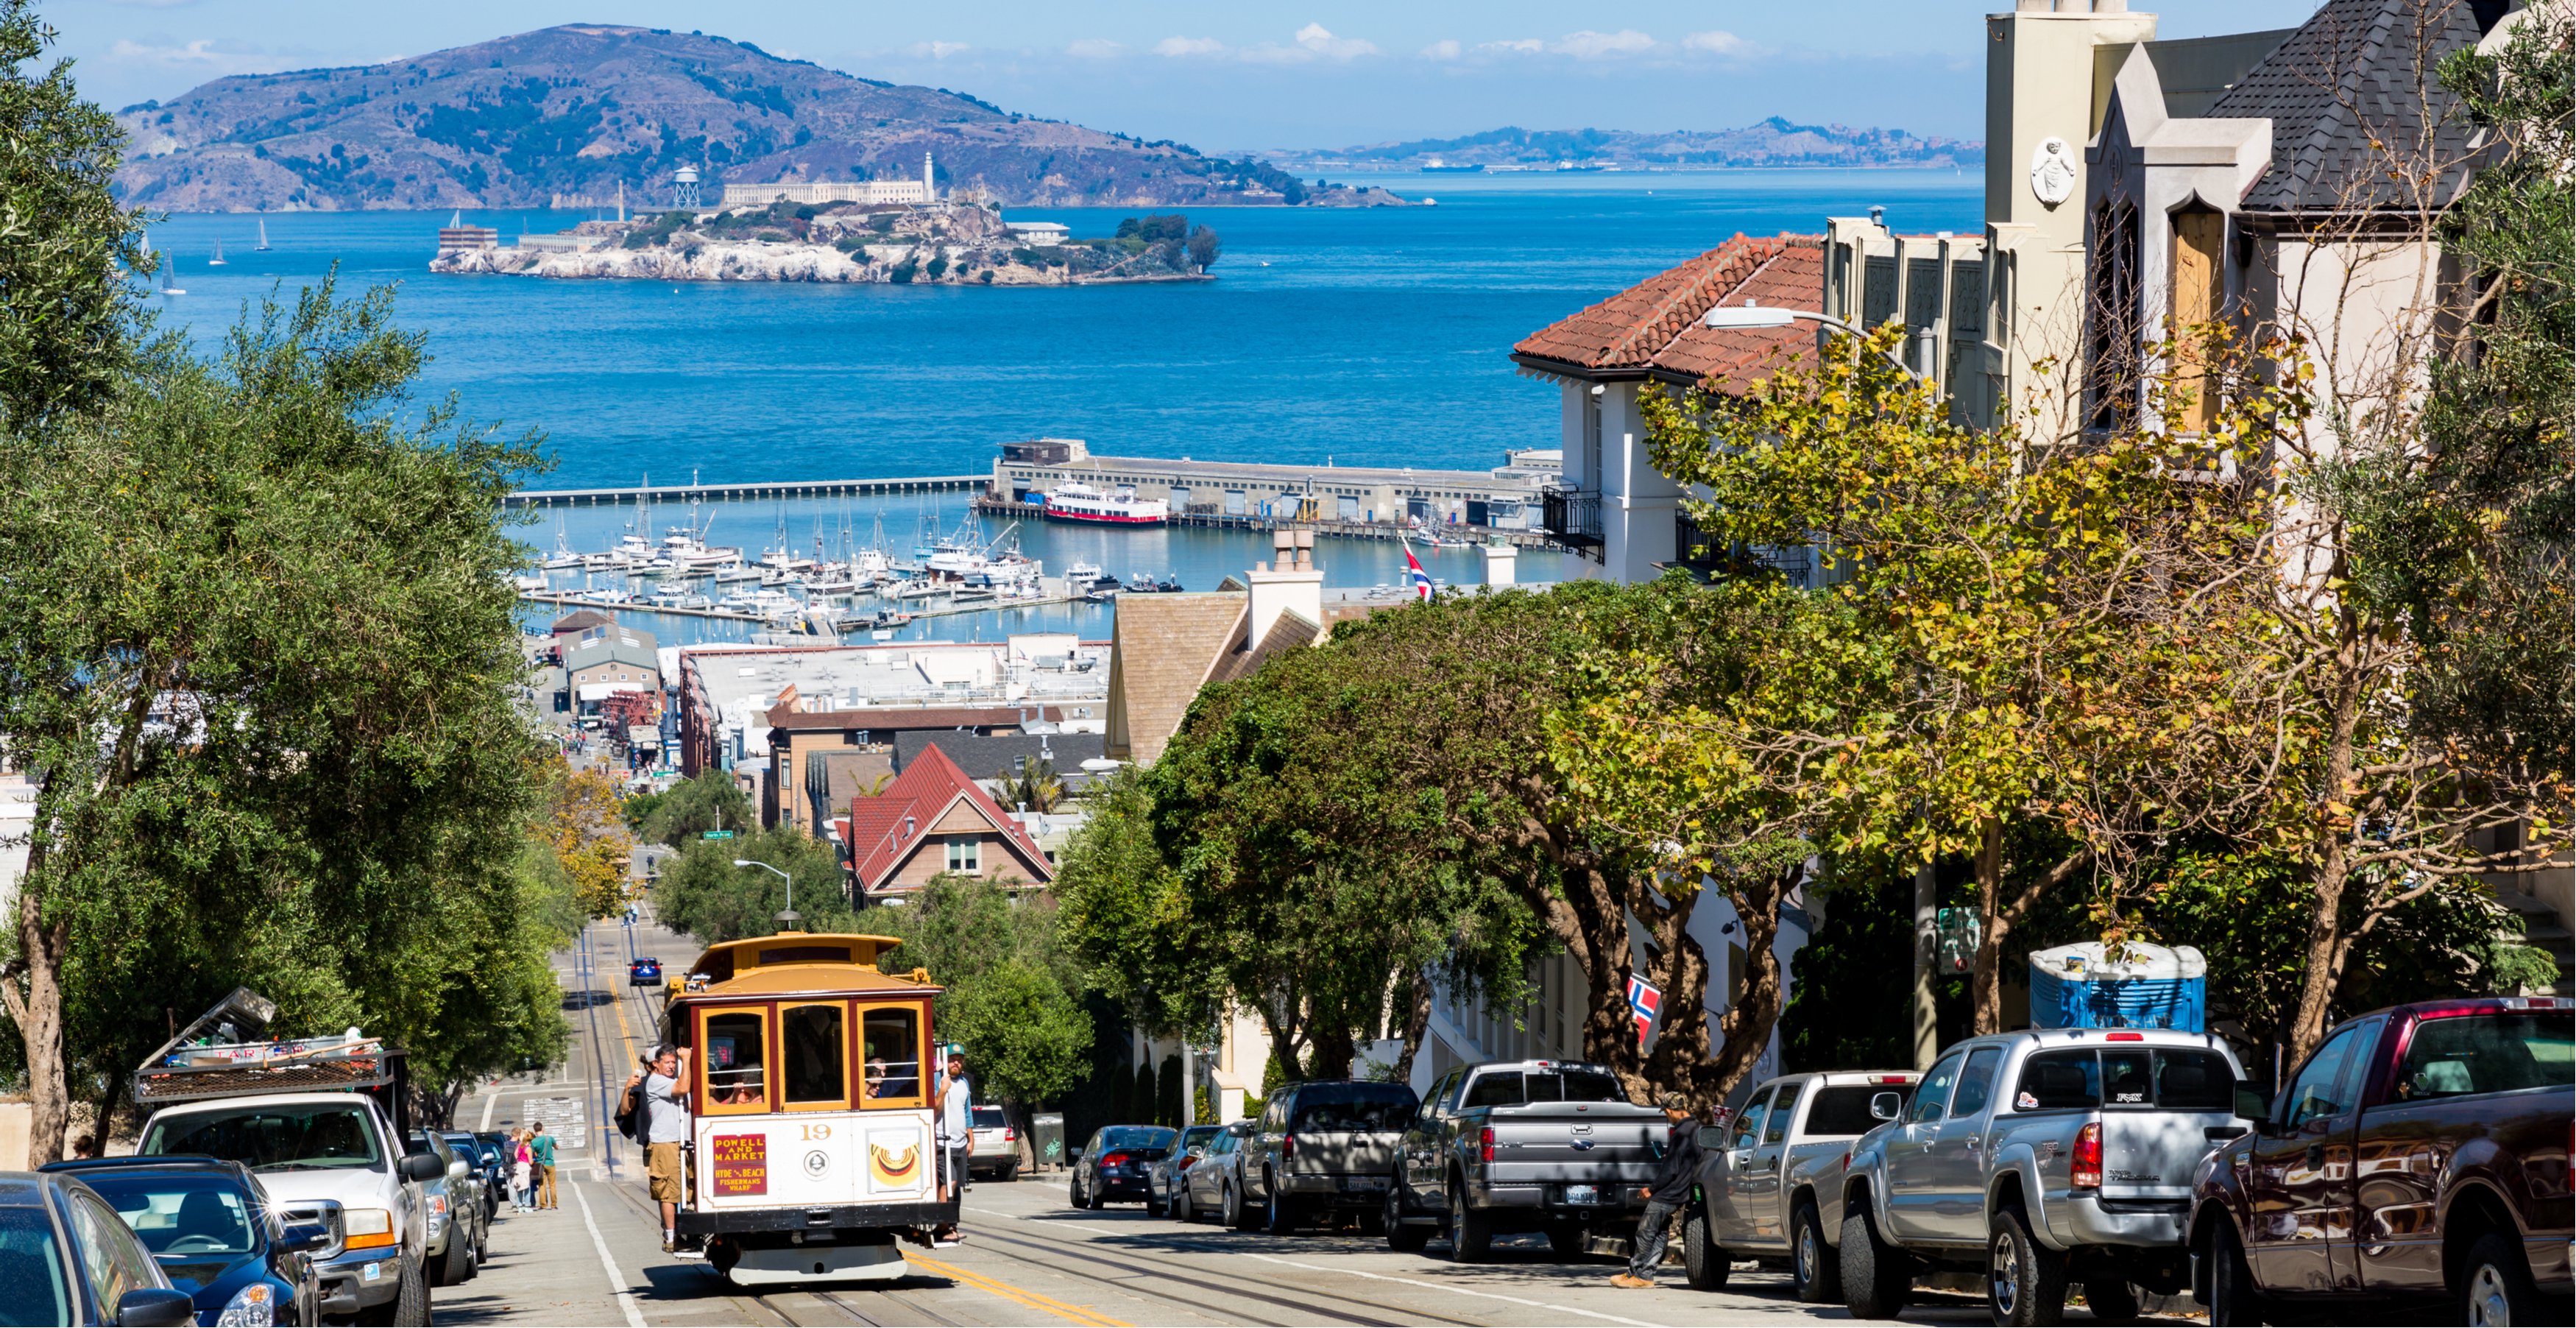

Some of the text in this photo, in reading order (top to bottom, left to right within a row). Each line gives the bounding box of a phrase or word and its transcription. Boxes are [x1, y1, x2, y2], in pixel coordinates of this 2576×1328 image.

[1942, 912, 1953, 926] 2
[800, 1123, 832, 1141] 19
[715, 1139, 763, 1148] POWELL
[715, 1152, 765, 1161] MARKET
[715, 1169, 732, 1178] HYDE
[743, 1168, 765, 1178] BEACH
